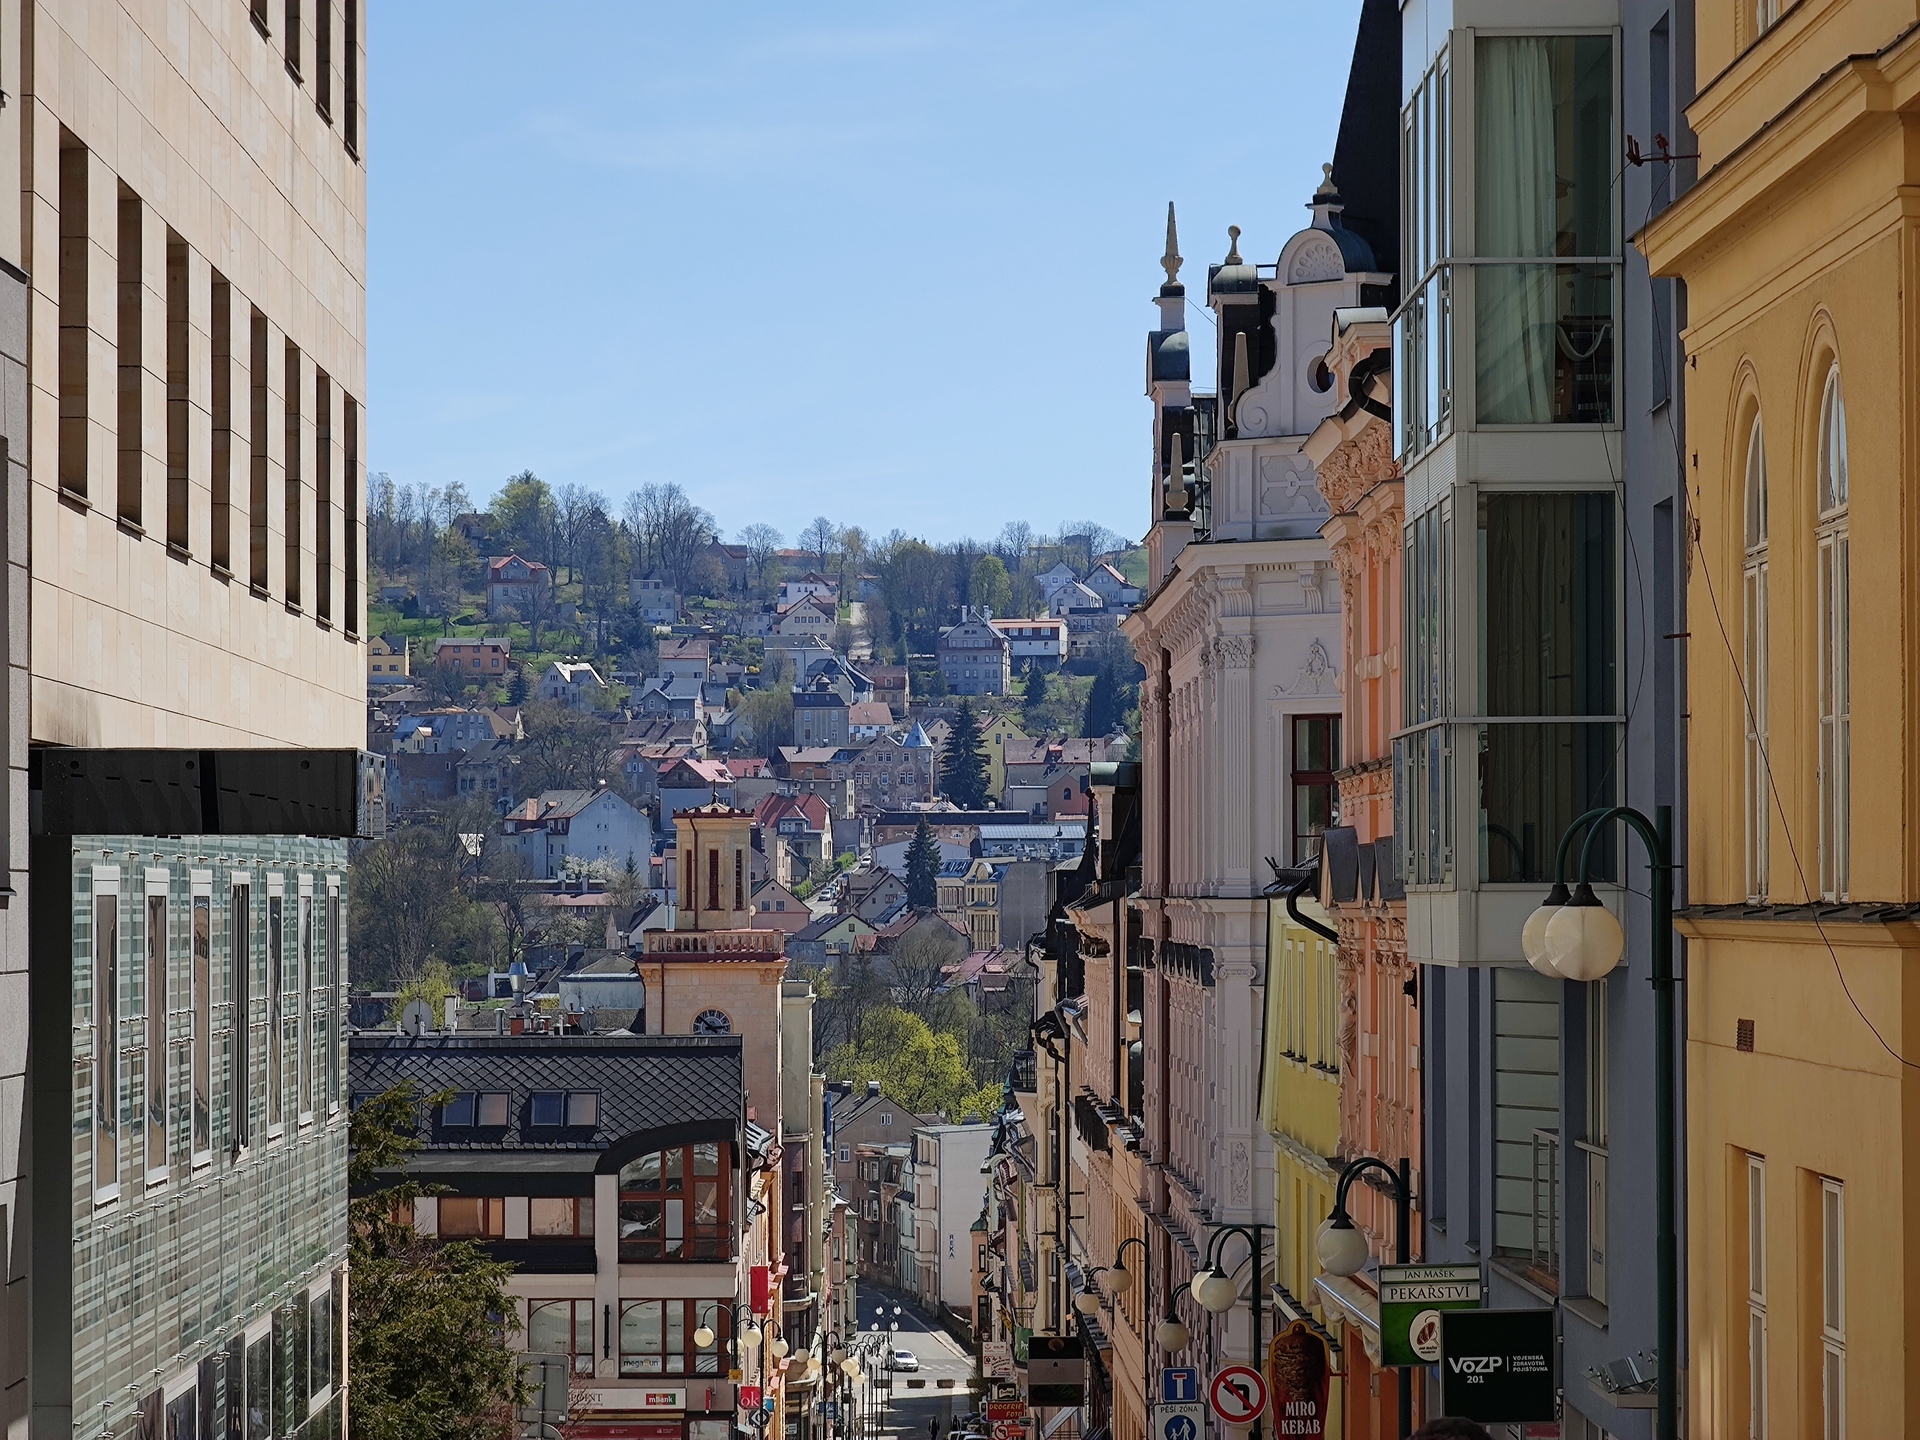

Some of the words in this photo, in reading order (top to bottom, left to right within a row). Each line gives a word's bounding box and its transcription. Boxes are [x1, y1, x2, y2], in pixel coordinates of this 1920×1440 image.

[1403, 1270, 1421, 1279] JAN
[1423, 1269, 1456, 1279] MAŠEK
[1390, 1283, 1470, 1300] PEKAŘSTVÍ
[1466, 1375, 1484, 1384] 201
[648, 1395, 673, 1403] mBank
[740, 1391, 760, 1407] ok
[1179, 1405, 1199, 1413] ZÓNA
[1285, 1401, 1316, 1417] MIRO
[1281, 1418, 1321, 1435] KEBAB
